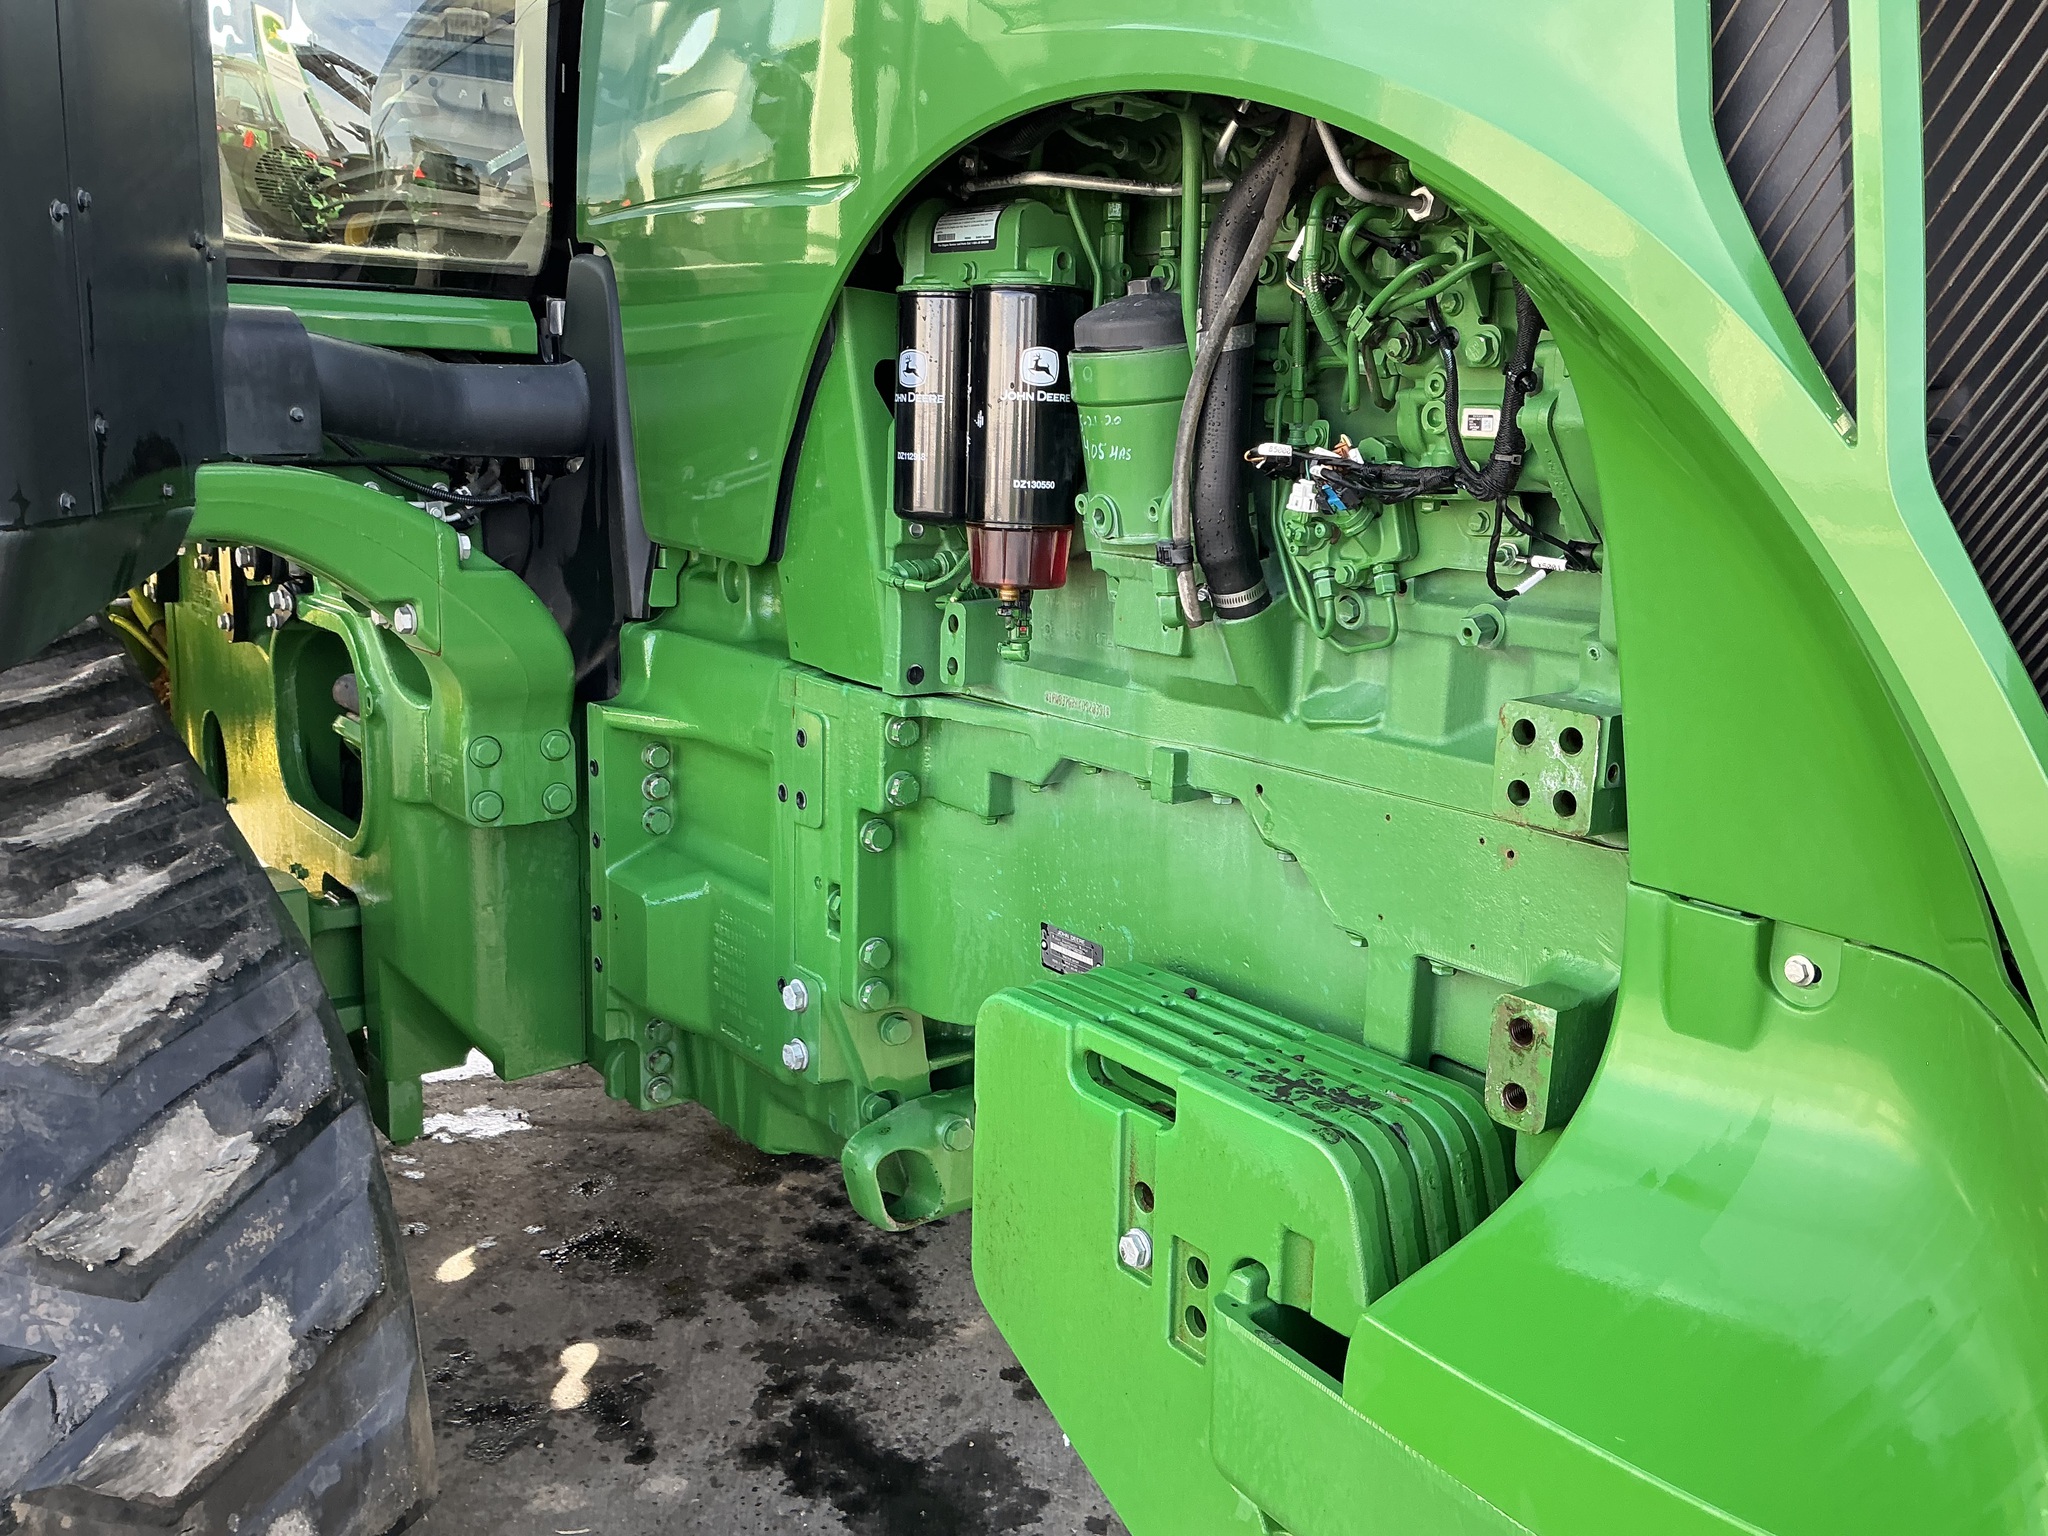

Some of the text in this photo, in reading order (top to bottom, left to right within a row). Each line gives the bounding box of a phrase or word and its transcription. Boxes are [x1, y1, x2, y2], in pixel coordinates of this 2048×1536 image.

[908, 392, 945, 403] DEERE
[1000, 390, 1070, 402] JOHN DEERE
[1083, 435, 1106, 461] 405
[1013, 480, 1055, 489] DZ130550
